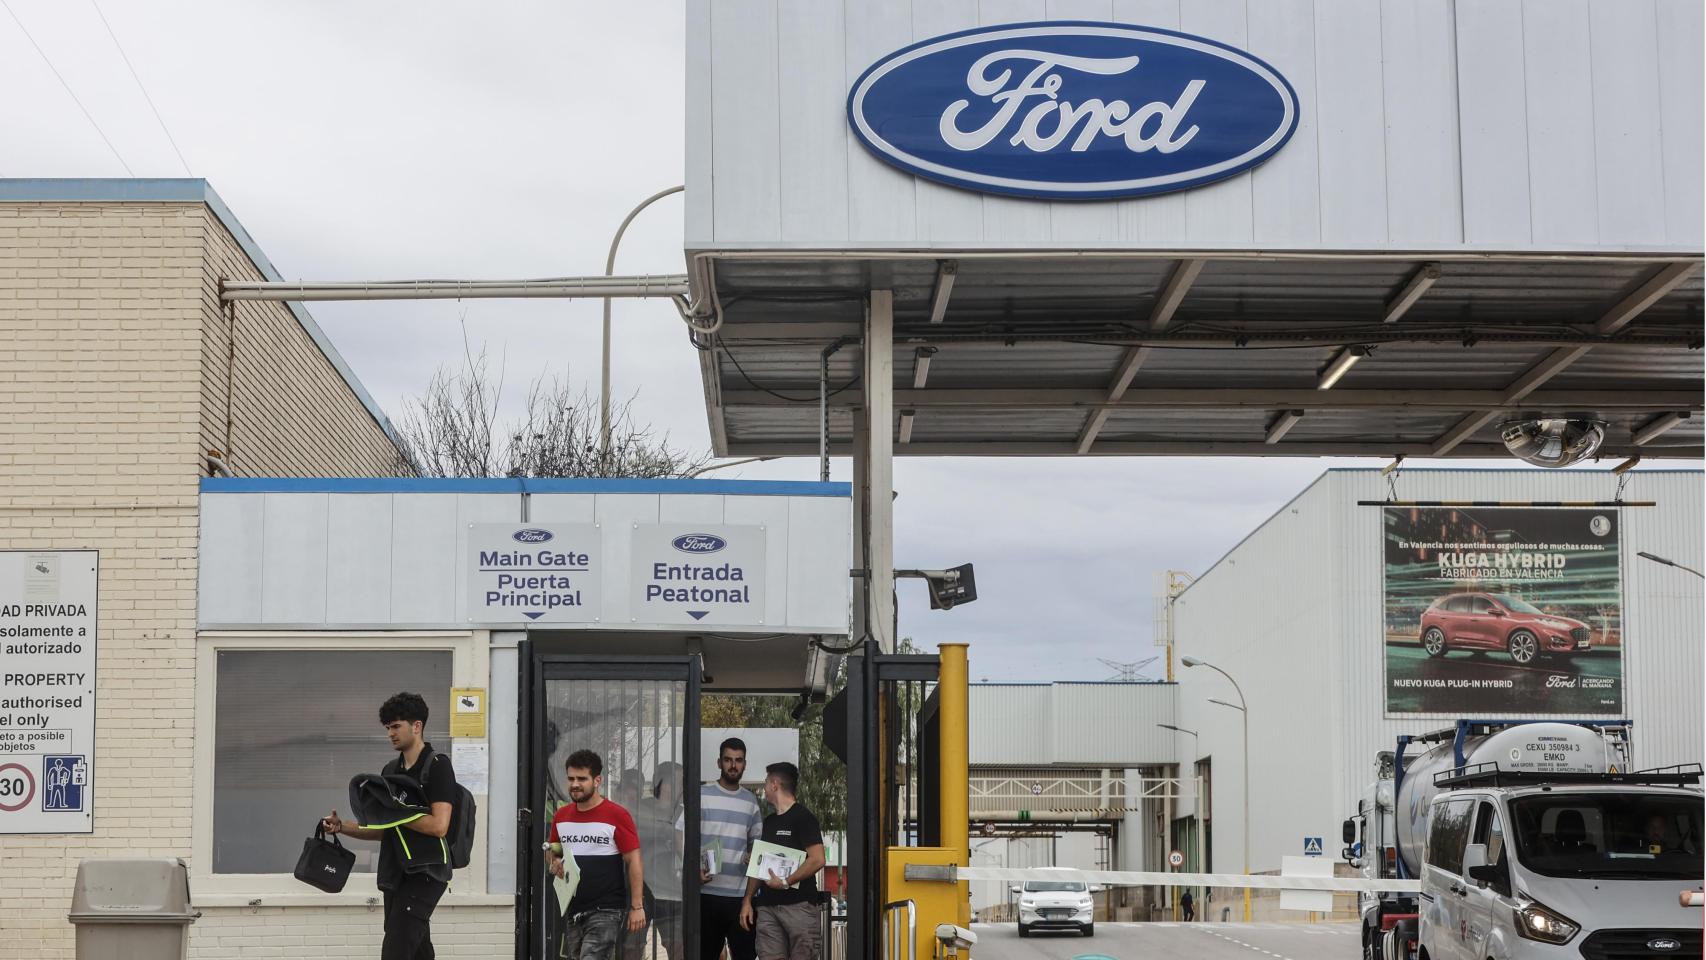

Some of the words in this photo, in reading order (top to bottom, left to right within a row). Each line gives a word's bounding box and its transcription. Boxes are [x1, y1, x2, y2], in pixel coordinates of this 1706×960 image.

[940, 49, 1207, 154] Ford
[520, 530, 546, 541] Ford
[682, 536, 716, 551] Ford
[1399, 541, 1409, 549] En
[1410, 541, 1443, 549] Valencia
[1460, 542, 1496, 550] sentimos
[1496, 542, 1537, 551] orgullosos
[1538, 542, 1549, 550] de
[1550, 542, 1579, 550] muchas
[480, 551, 532, 566] Main
[537, 551, 589, 566] Gate
[1438, 553, 1489, 568] KUGA
[1494, 553, 1566, 568] HYBRID
[653, 563, 744, 581] Entrada
[1440, 569, 1497, 578] FABRICADO
[1499, 569, 1512, 578] EN
[1515, 569, 1564, 579] VALENCIA
[498, 574, 570, 589] Puerta
[486, 590, 582, 609] Principal
[646, 584, 750, 603] Peatonal
[0, 604, 21, 617] AD
[25, 604, 87, 617] PRIVADA
[0, 625, 74, 637] solamente
[78, 627, 86, 637] a
[6, 642, 82, 654] autorizado
[4, 673, 86, 686] PROPERTY
[1393, 679, 1422, 687] NUEVO
[1423, 679, 1446, 688] KUGA
[1447, 680, 1481, 688] PLUG-IN
[1482, 680, 1513, 688] HYBRID
[1546, 675, 1576, 689] Ford
[1, 696, 82, 708] authorised
[17, 713, 49, 728] only
[18, 733, 25, 741] a
[27, 731, 65, 742] posible
[1526, 743, 1546, 751] CEXU
[1548, 743, 1573, 752] 350984
[1575, 744, 1581, 752] 3
[1543, 753, 1566, 761] EMKD
[0, 777, 25, 796] 30
[560, 835, 610, 844] CK&JONES
[1654, 940, 1674, 948] Ford
